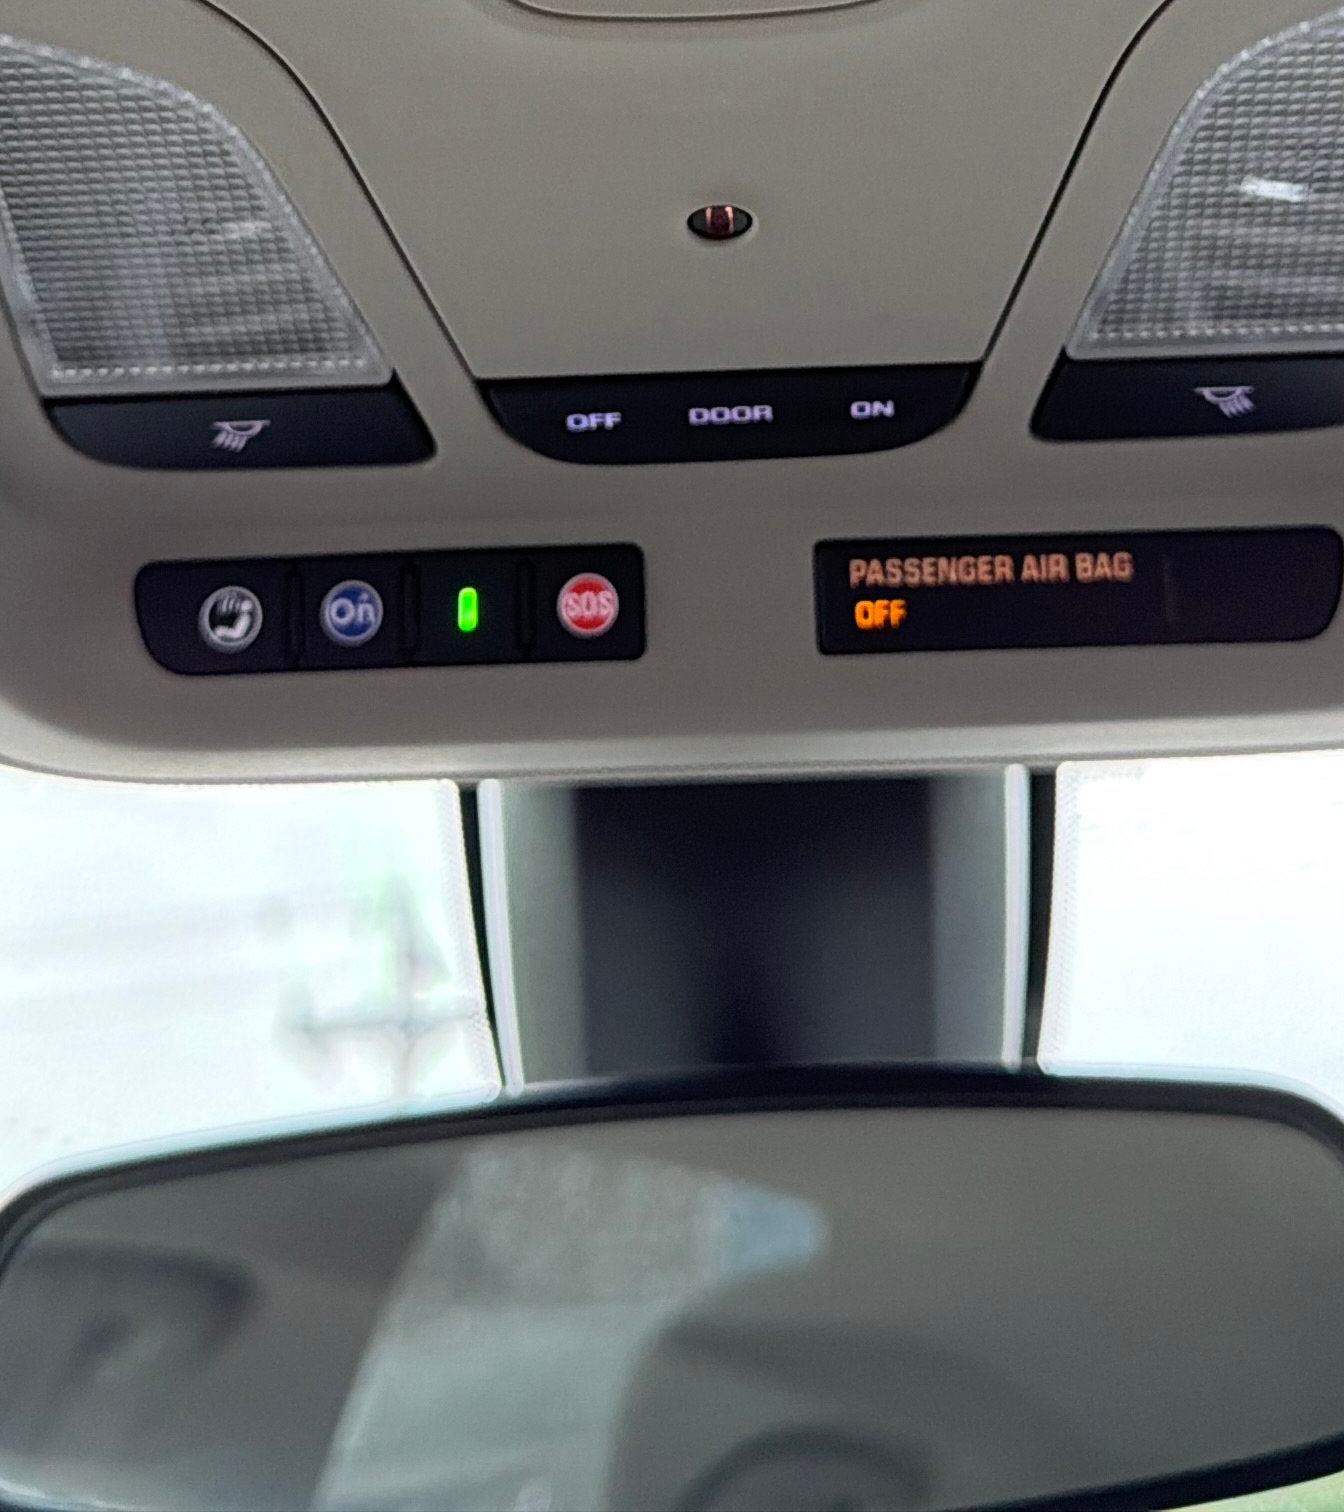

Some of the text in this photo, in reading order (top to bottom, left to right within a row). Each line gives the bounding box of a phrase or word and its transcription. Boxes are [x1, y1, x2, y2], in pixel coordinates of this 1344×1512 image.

[566, 400, 895, 432] OFF DOOR ON
[849, 551, 1135, 587] PASSENGER AIR BAG
[565, 590, 614, 618] SOS
[855, 599, 908, 630] OFF
